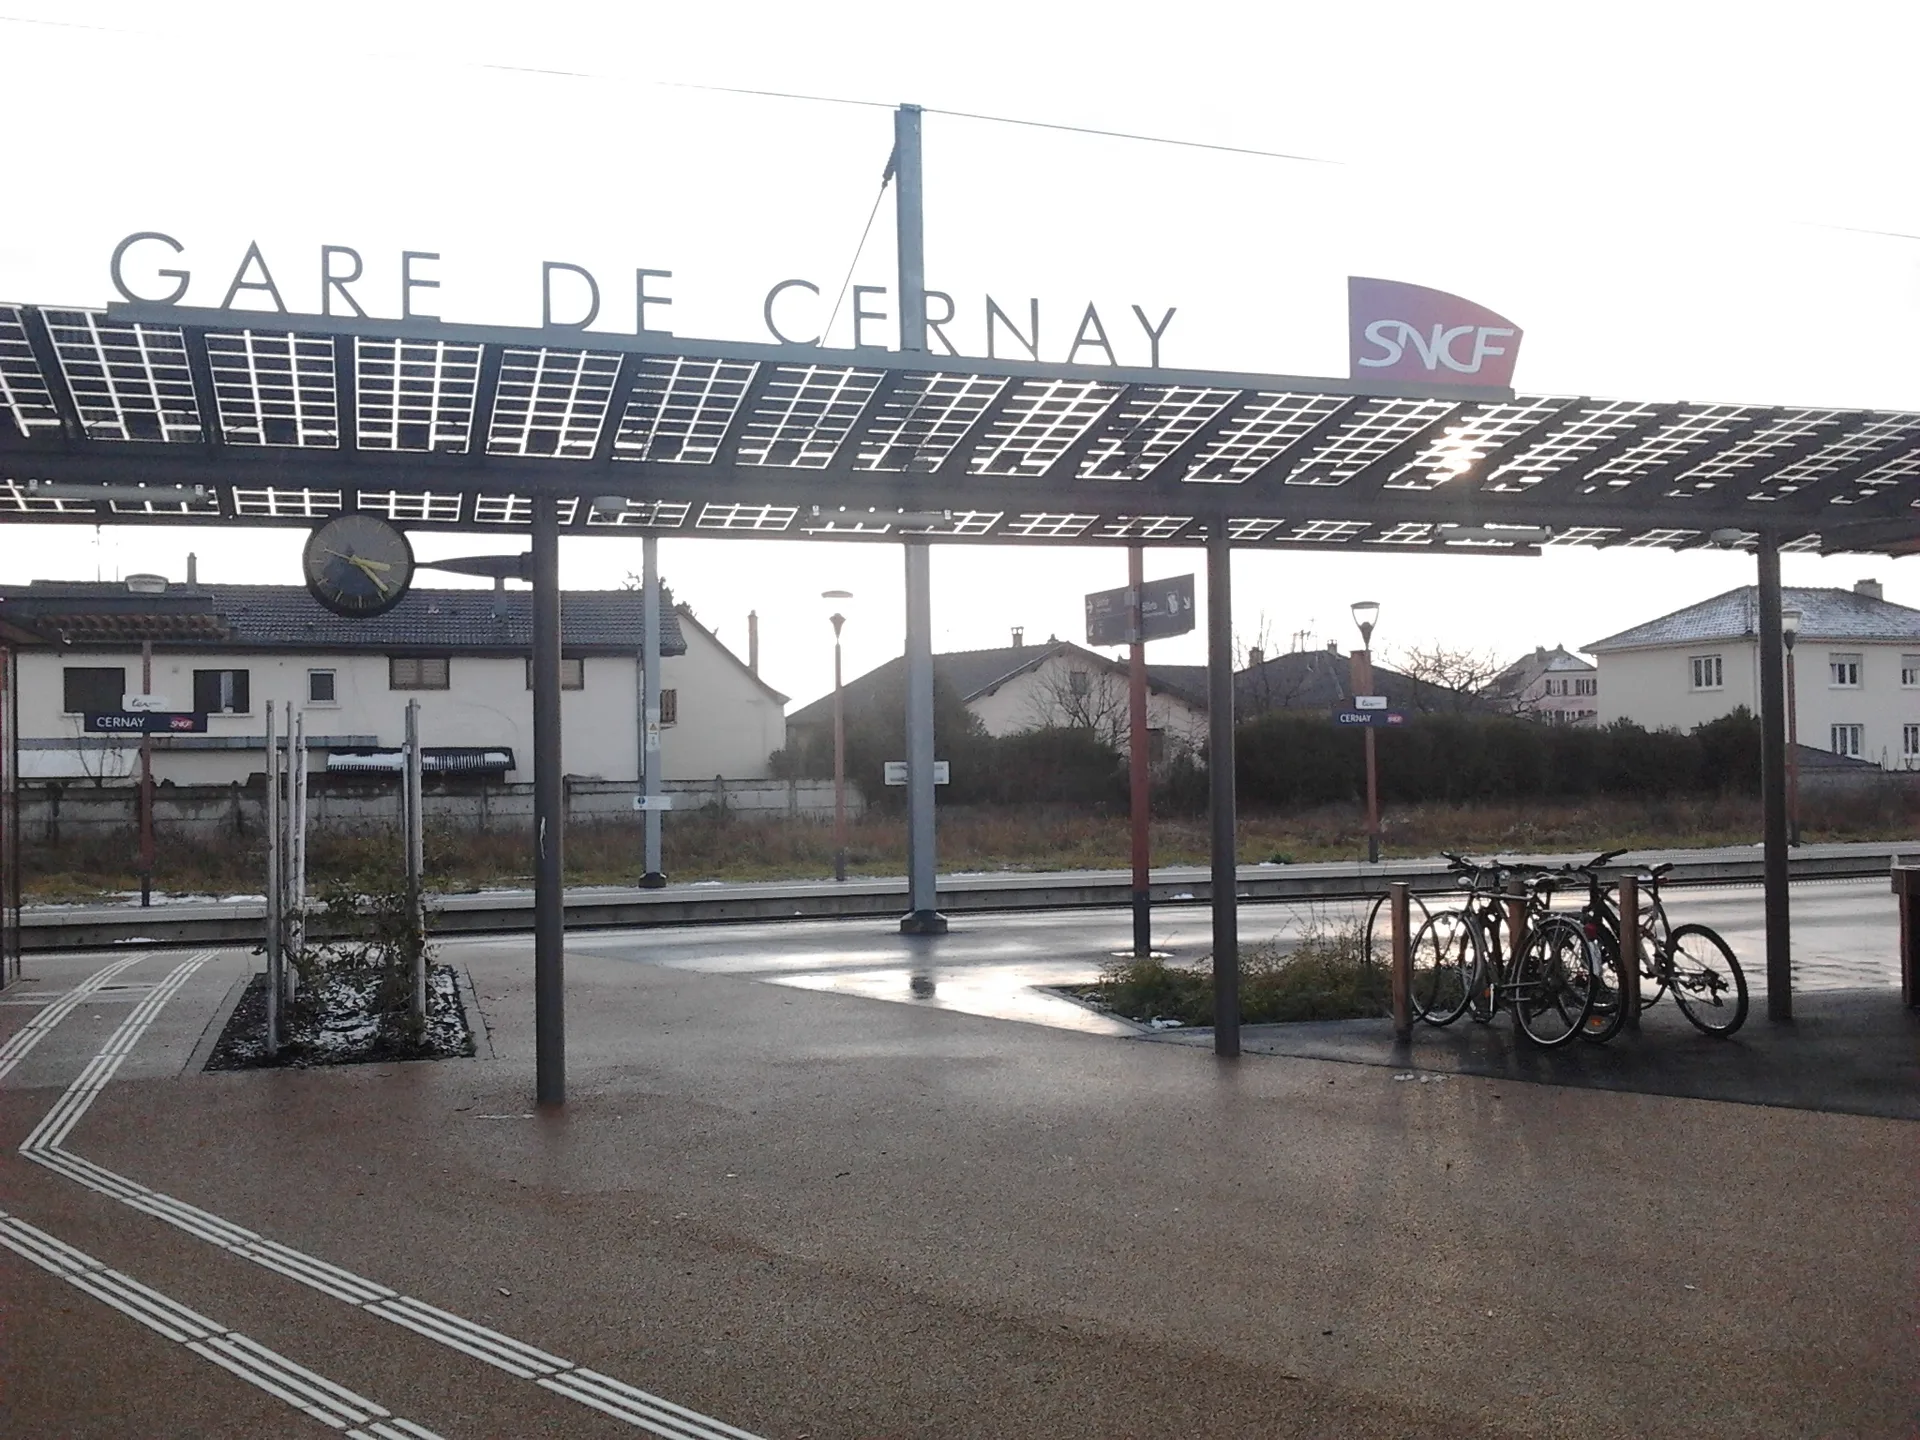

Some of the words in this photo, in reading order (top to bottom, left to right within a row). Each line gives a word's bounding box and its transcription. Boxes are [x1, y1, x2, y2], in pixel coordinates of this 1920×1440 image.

[110, 231, 441, 323] GARE
[542, 260, 673, 336] DE
[763, 278, 1178, 369] CERNAY
[1357, 319, 1515, 374] SNCF
[96, 716, 146, 728] CERNAY
[1339, 713, 1372, 723] CERNAY
